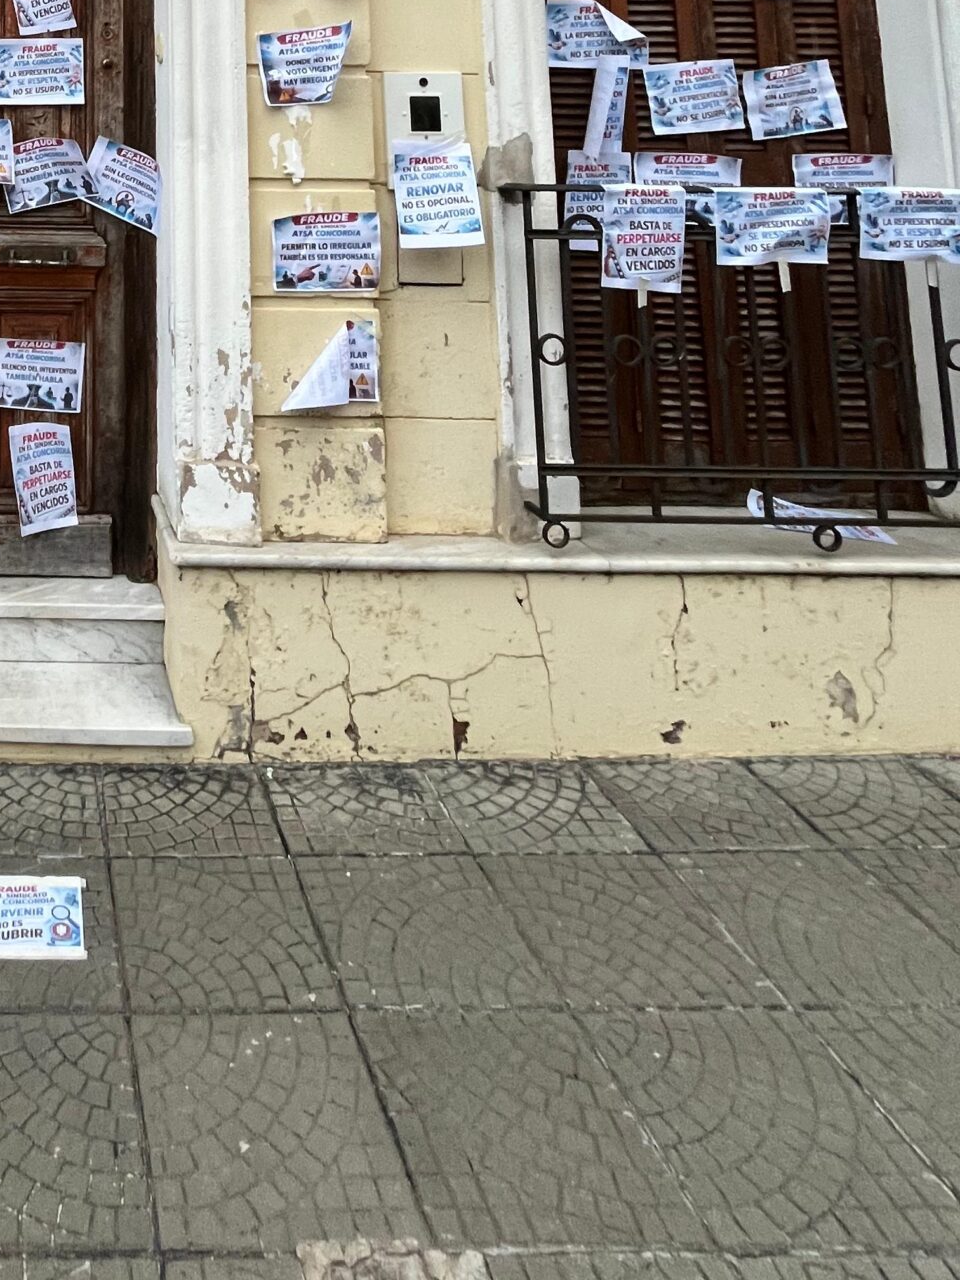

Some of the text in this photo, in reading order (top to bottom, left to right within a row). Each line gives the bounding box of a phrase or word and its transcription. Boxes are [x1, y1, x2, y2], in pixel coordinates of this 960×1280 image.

[285, 28, 332, 43] FRAUDE
[22, 44, 58, 53] FRAUDE
[286, 58, 312, 66] DONDE
[286, 67, 308, 76] VOTO
[680, 66, 713, 78] FRAUDE
[35, 84, 64, 93] USURPA
[409, 157, 448, 165] FRAUDE
[662, 155, 708, 163] FRAUDE
[818, 156, 862, 165] FRAUDE
[421, 171, 466, 179] CONCORDIA
[407, 183, 464, 197] RENOVAR
[625, 189, 669, 197] FRAUDE
[754, 191, 796, 201] FRAUDE
[769, 199, 804, 207] SINDICATO
[637, 206, 683, 214] CONCORDIA
[300, 214, 349, 224] FRAUDE
[404, 208, 475, 223] ES OBLIGATORIO
[630, 221, 660, 230] BASTA
[749, 218, 815, 230] REPRESENTACIÓN
[617, 234, 682, 244] PERPETUARSE
[626, 246, 676, 256] EN CARGOS
[626, 260, 676, 271] VENCIDOS
[13, 341, 57, 349] FRAUDE
[1, 363, 27, 371] SILENCIO
[22, 432, 58, 444] FRAUDE
[29, 460, 63, 475] BASTA DE
[22, 470, 72, 490] PERPETUARSE
[30, 484, 68, 502] EN CARGOS
[31, 495, 69, 515] VENCIDOS
[3, 897, 55, 905] CONCORDIA
